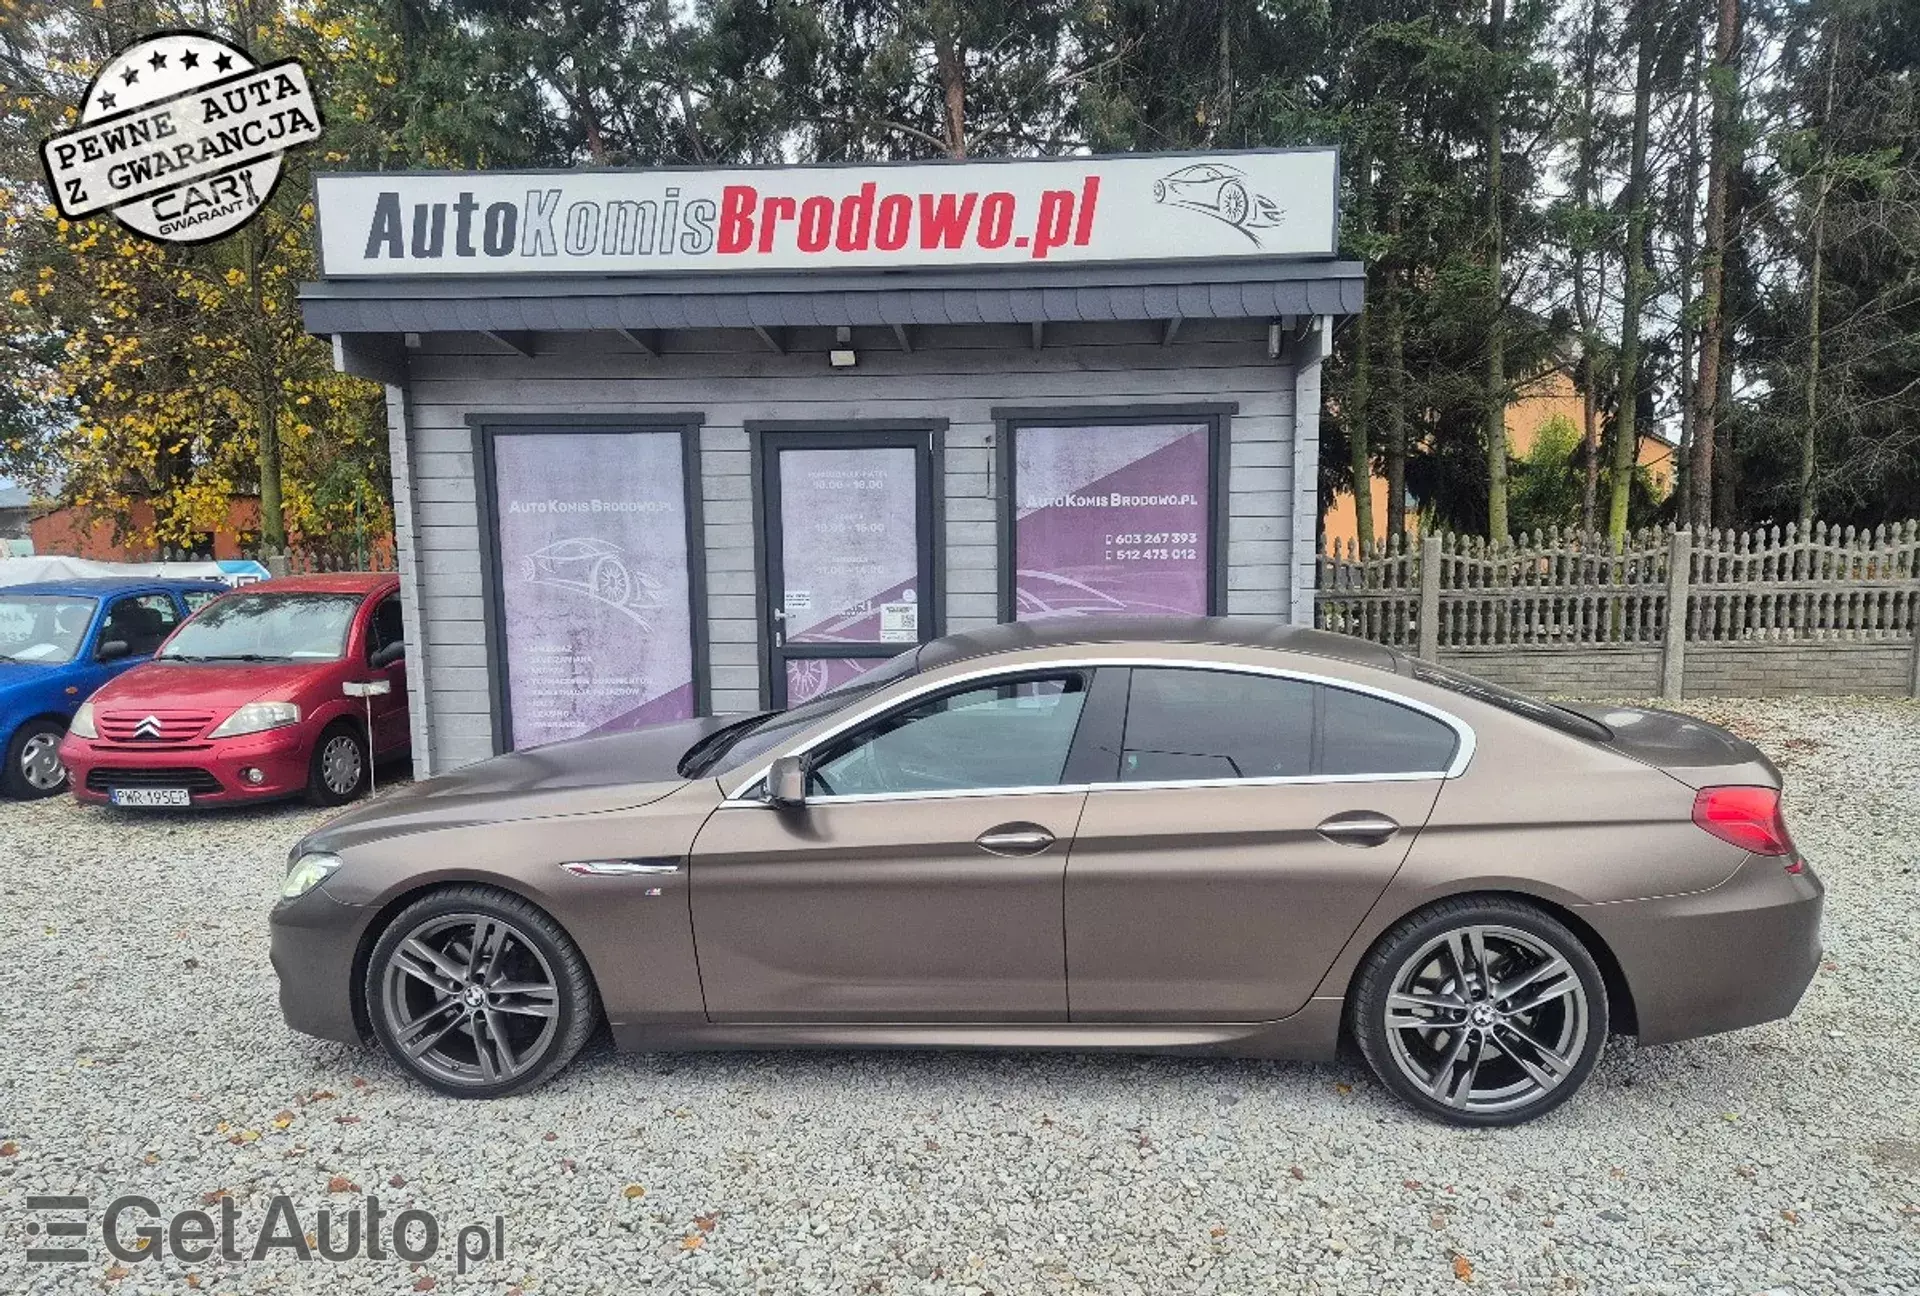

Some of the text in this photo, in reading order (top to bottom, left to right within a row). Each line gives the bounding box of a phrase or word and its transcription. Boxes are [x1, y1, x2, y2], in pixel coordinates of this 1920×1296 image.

[364, 176, 1100, 259] AutoKomisBrodowo.pl
[1115, 532, 1198, 545] 603 267 393
[1116, 549, 1140, 560] 512
[1171, 549, 1197, 559] 012
[117, 790, 143, 804] PWR
